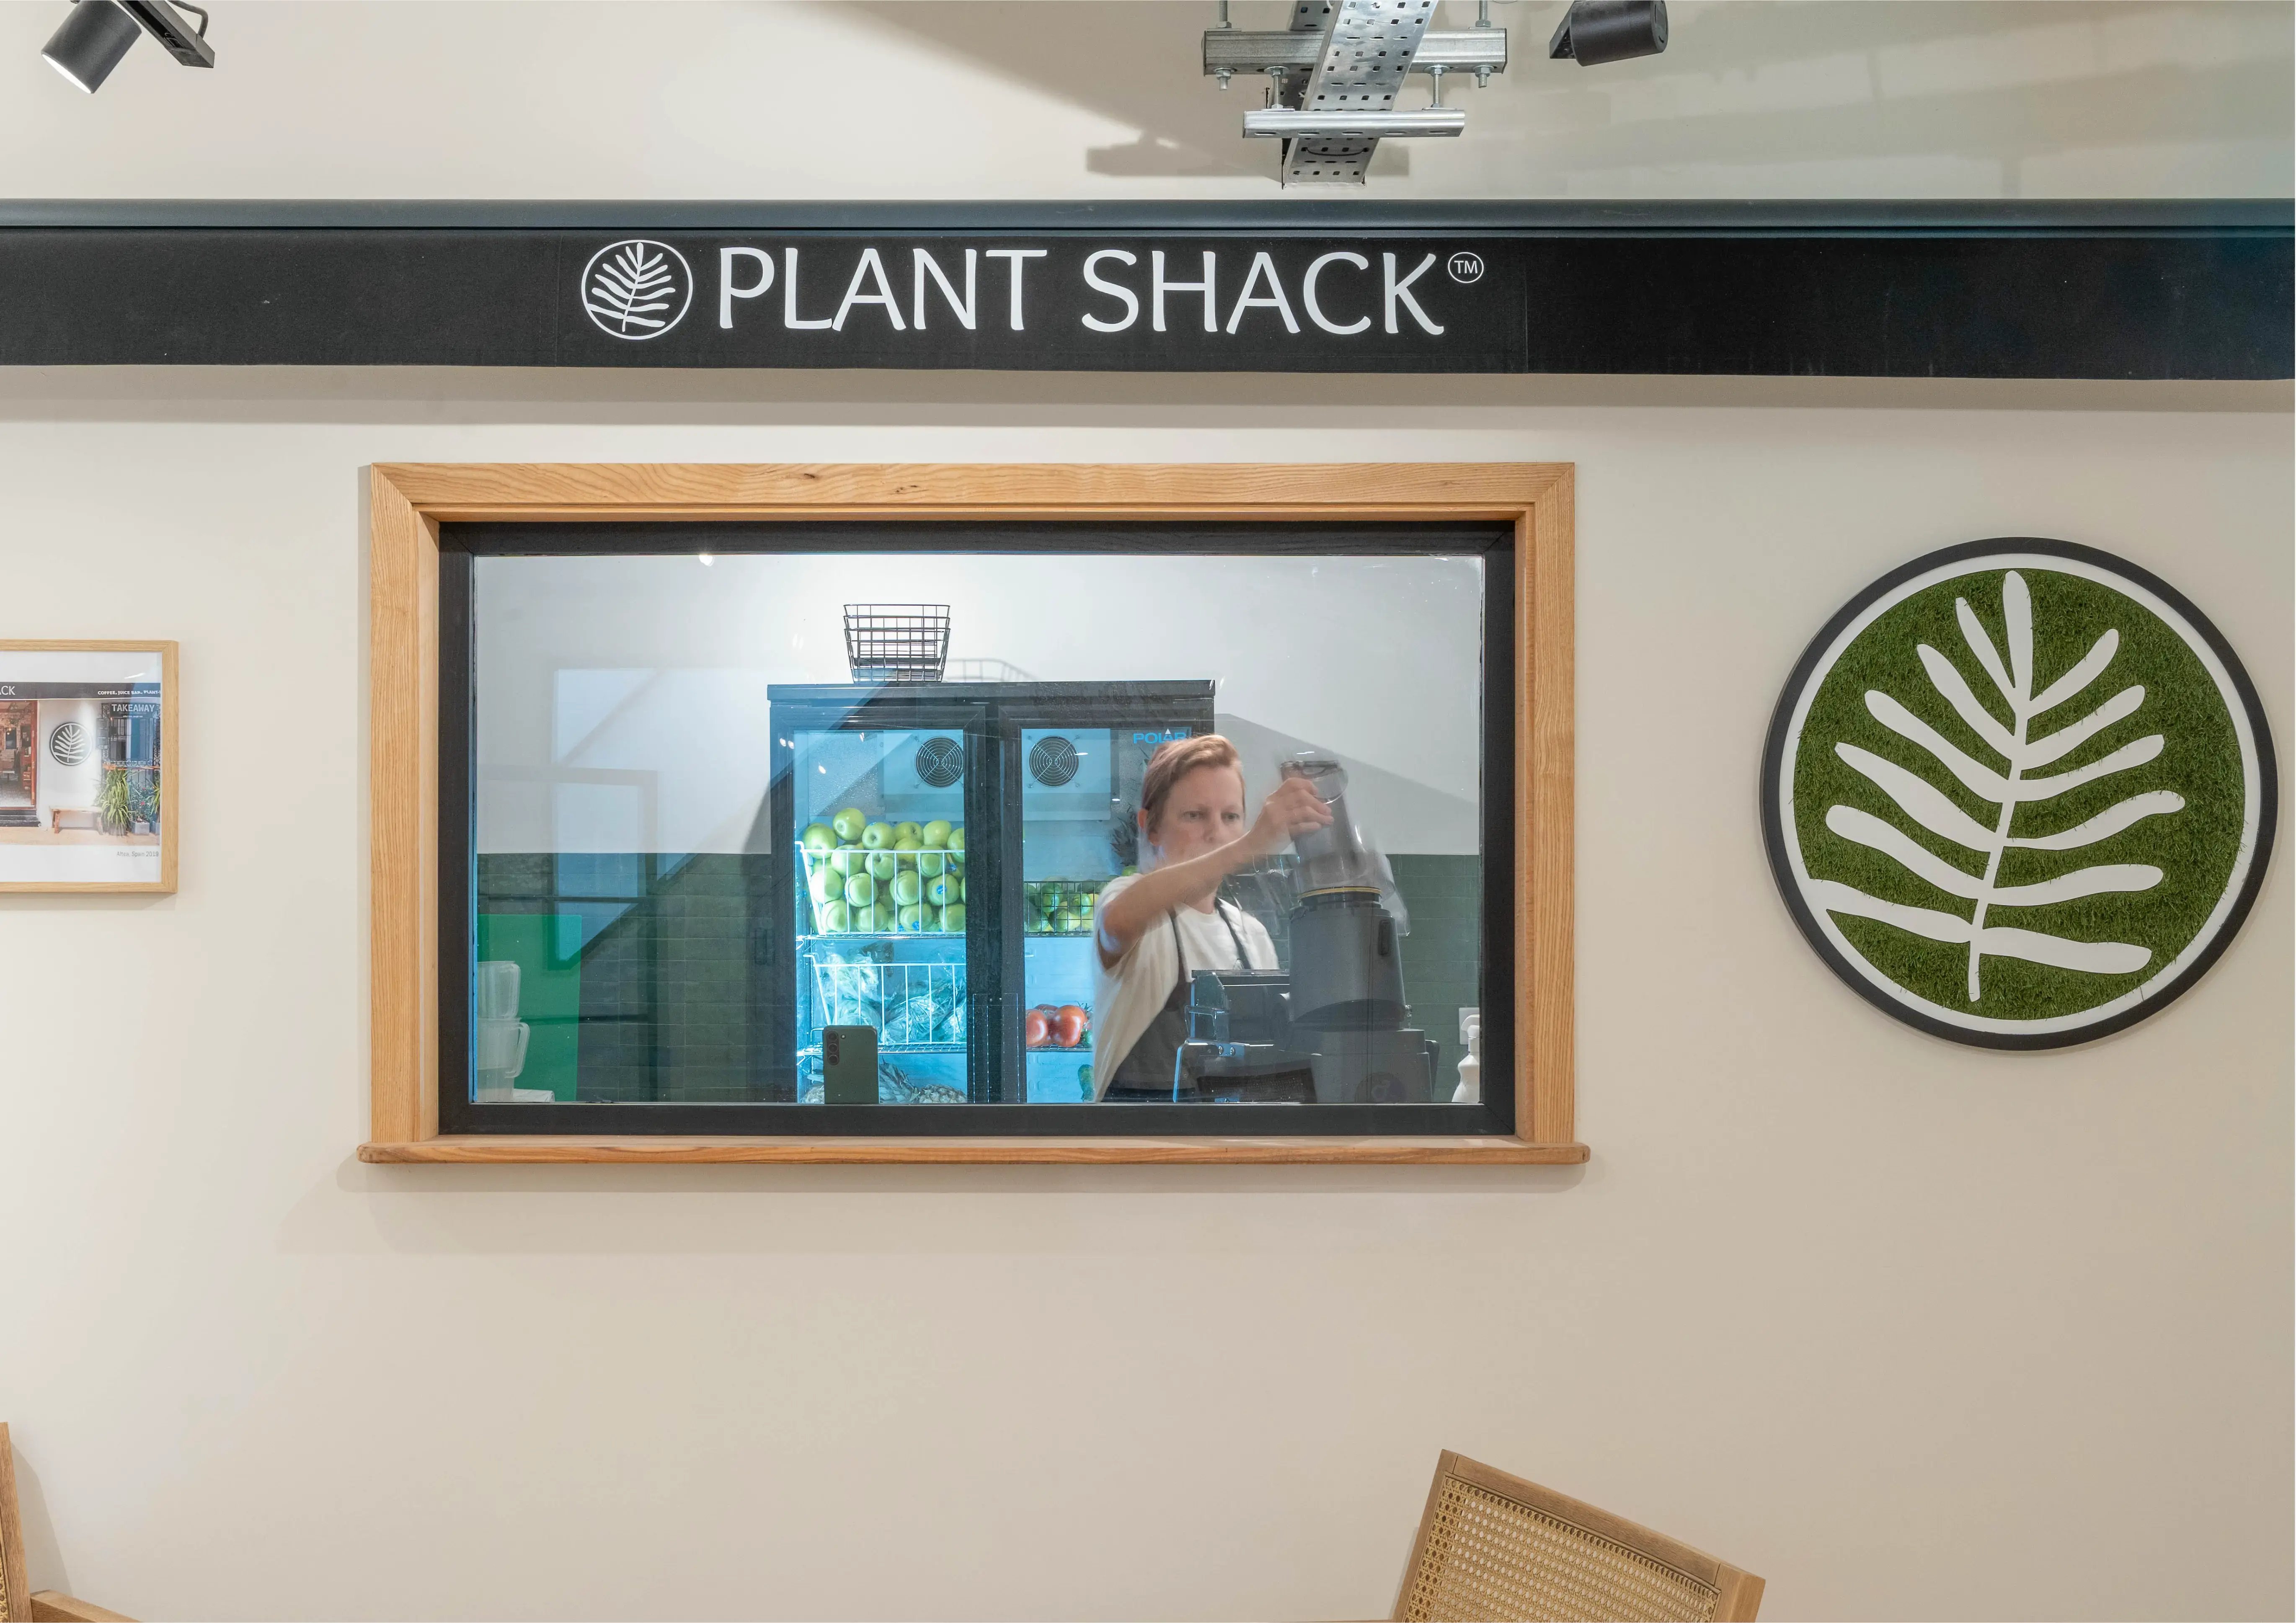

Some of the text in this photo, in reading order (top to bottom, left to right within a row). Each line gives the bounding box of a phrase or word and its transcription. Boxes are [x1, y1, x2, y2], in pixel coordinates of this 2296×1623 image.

[719, 246, 1047, 333] PLANT
[1082, 249, 1444, 335] SHACK
[0, 685, 15, 695] CK
